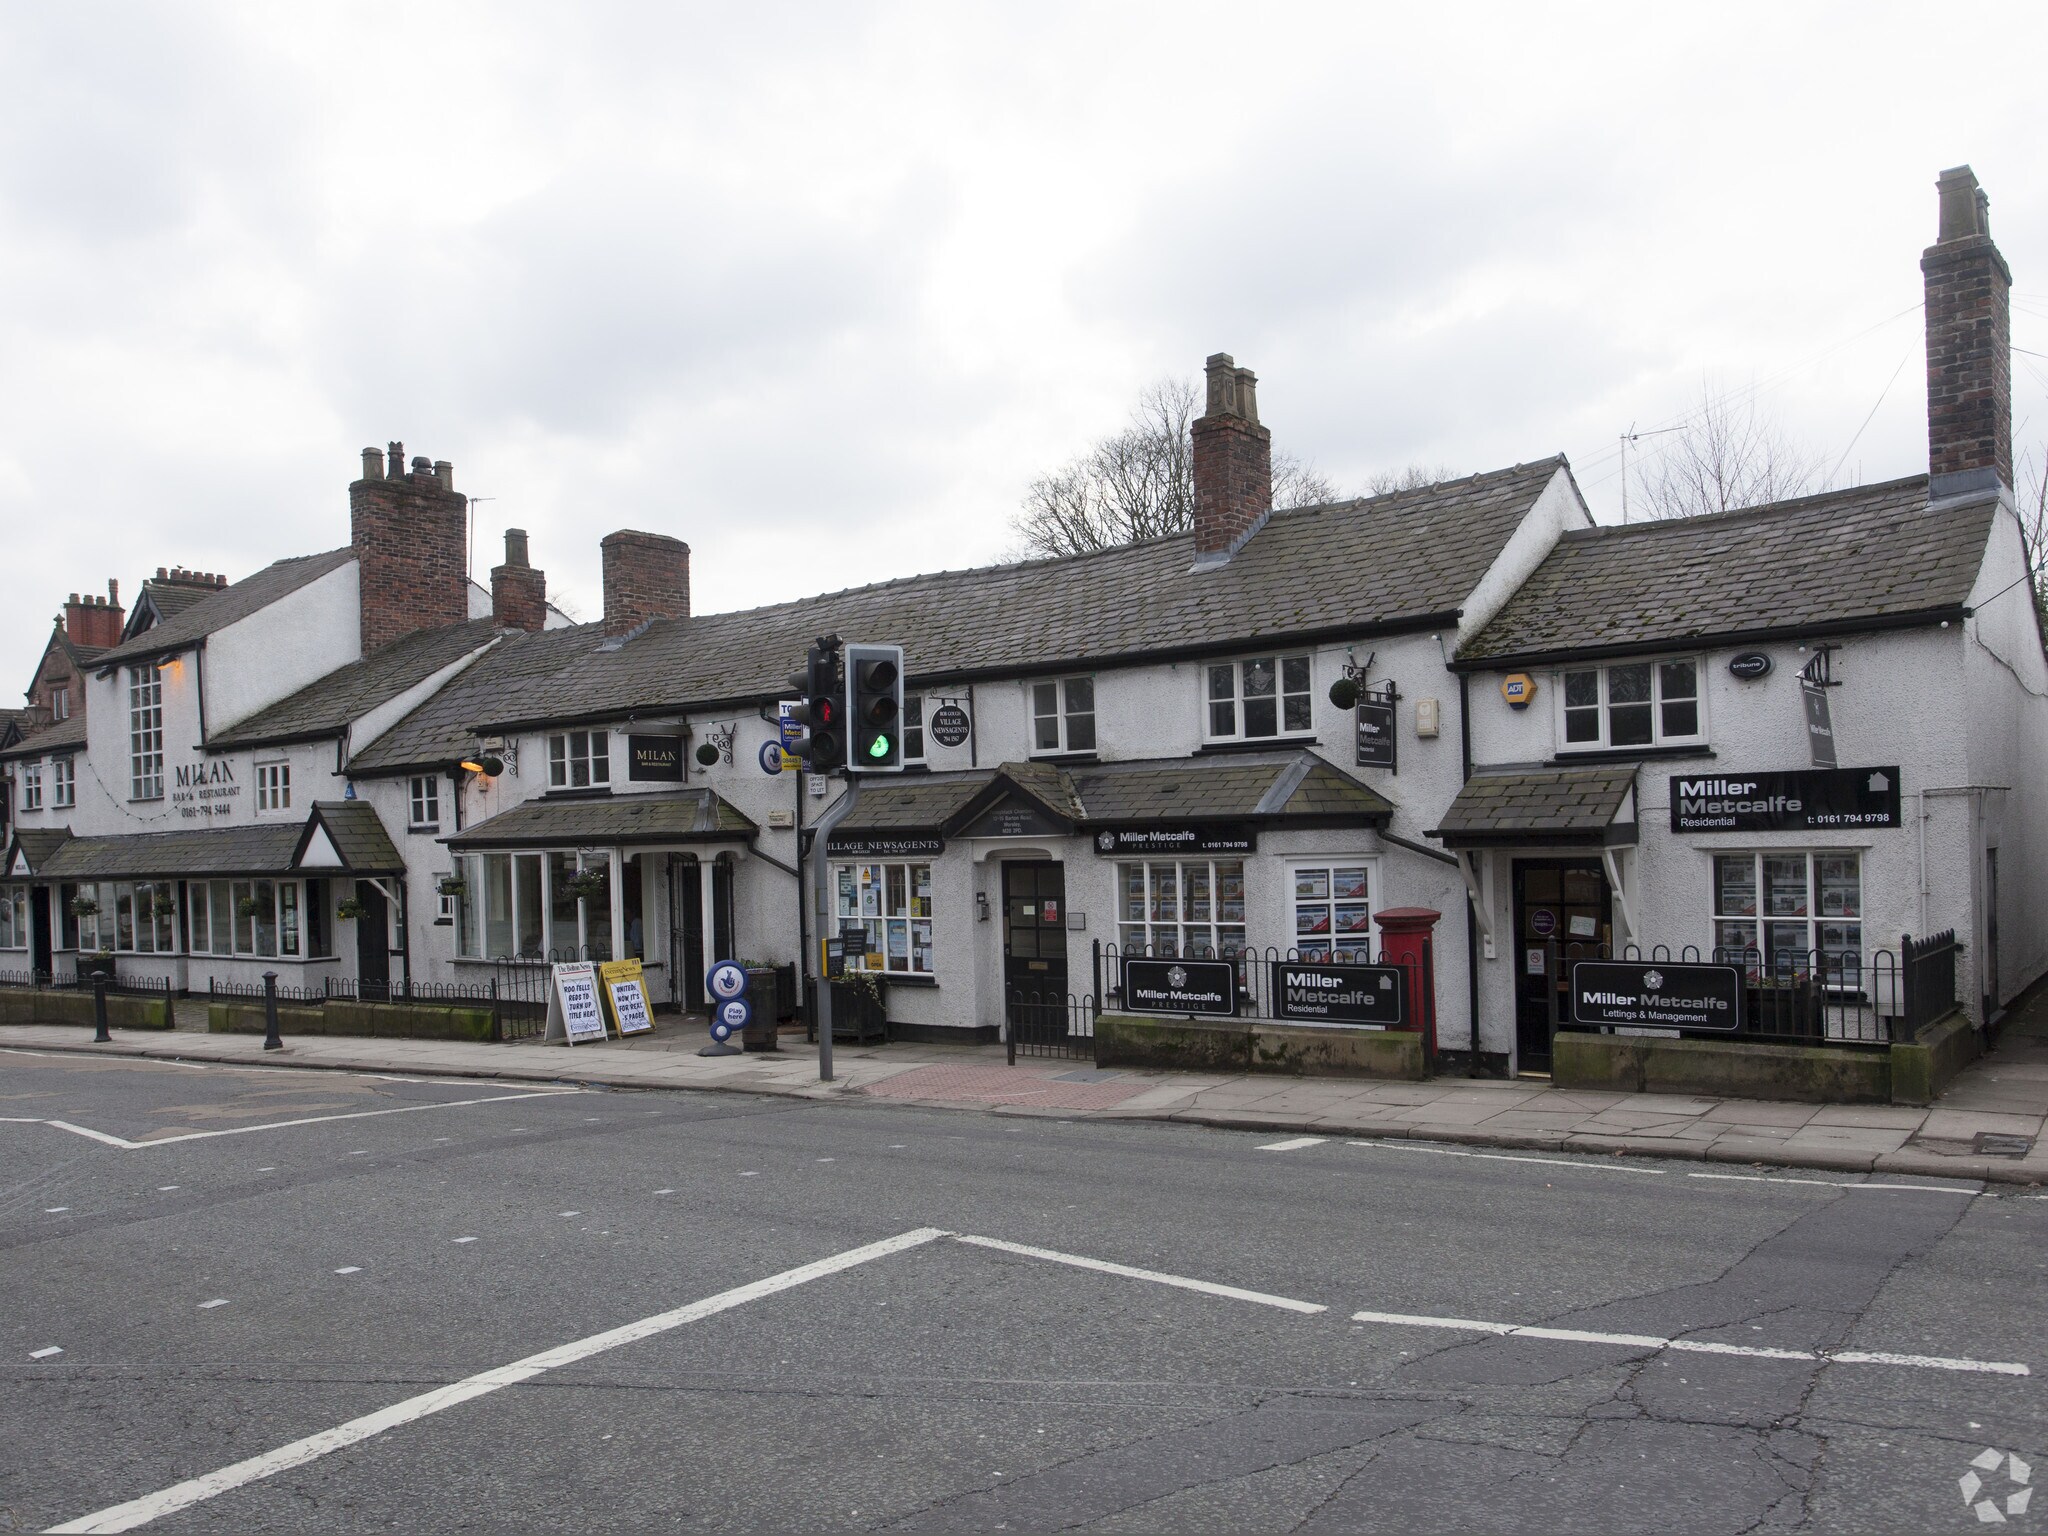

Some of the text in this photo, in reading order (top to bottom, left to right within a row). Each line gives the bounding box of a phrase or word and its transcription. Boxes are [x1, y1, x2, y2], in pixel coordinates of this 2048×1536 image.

[1733, 662, 1760, 670] tribune
[1360, 722, 1380, 733] Miller
[1360, 735, 1390, 746] Metcalfe
[637, 750, 676, 761] MILAN
[176, 760, 235, 787] MILAN
[173, 793, 186, 801] BAR
[199, 786, 241, 799] RESTAURANT
[1680, 780, 1756, 796] Miller
[214, 803, 230, 815] 5444
[1680, 796, 1802, 814] Metcalfe
[1680, 817, 1736, 827] Residential
[1817, 815, 1841, 823] 0161
[1844, 814, 1862, 823] 794
[1865, 813, 1889, 822] 9798
[1120, 831, 1195, 842] Miller Metcalfe
[827, 840, 939, 850] ILLAGE NEWSAGENTS
[1287, 973, 1343, 988] Miller
[576, 984, 590, 992] TELLS
[1137, 989, 1222, 1001] Miller Metcalfe
[1287, 988, 1375, 1005] Metcalfe
[1152, 1002, 1206, 1010] PRESTIGE
[1583, 992, 1728, 1010] Miller Metcalfe
[619, 1002, 642, 1012] FOR REAL
[1287, 1004, 1328, 1014] Residential
[583, 1010, 596, 1018] HEAT
[1603, 1009, 1637, 1020] Lettings
[1648, 1011, 1707, 1022] Management
